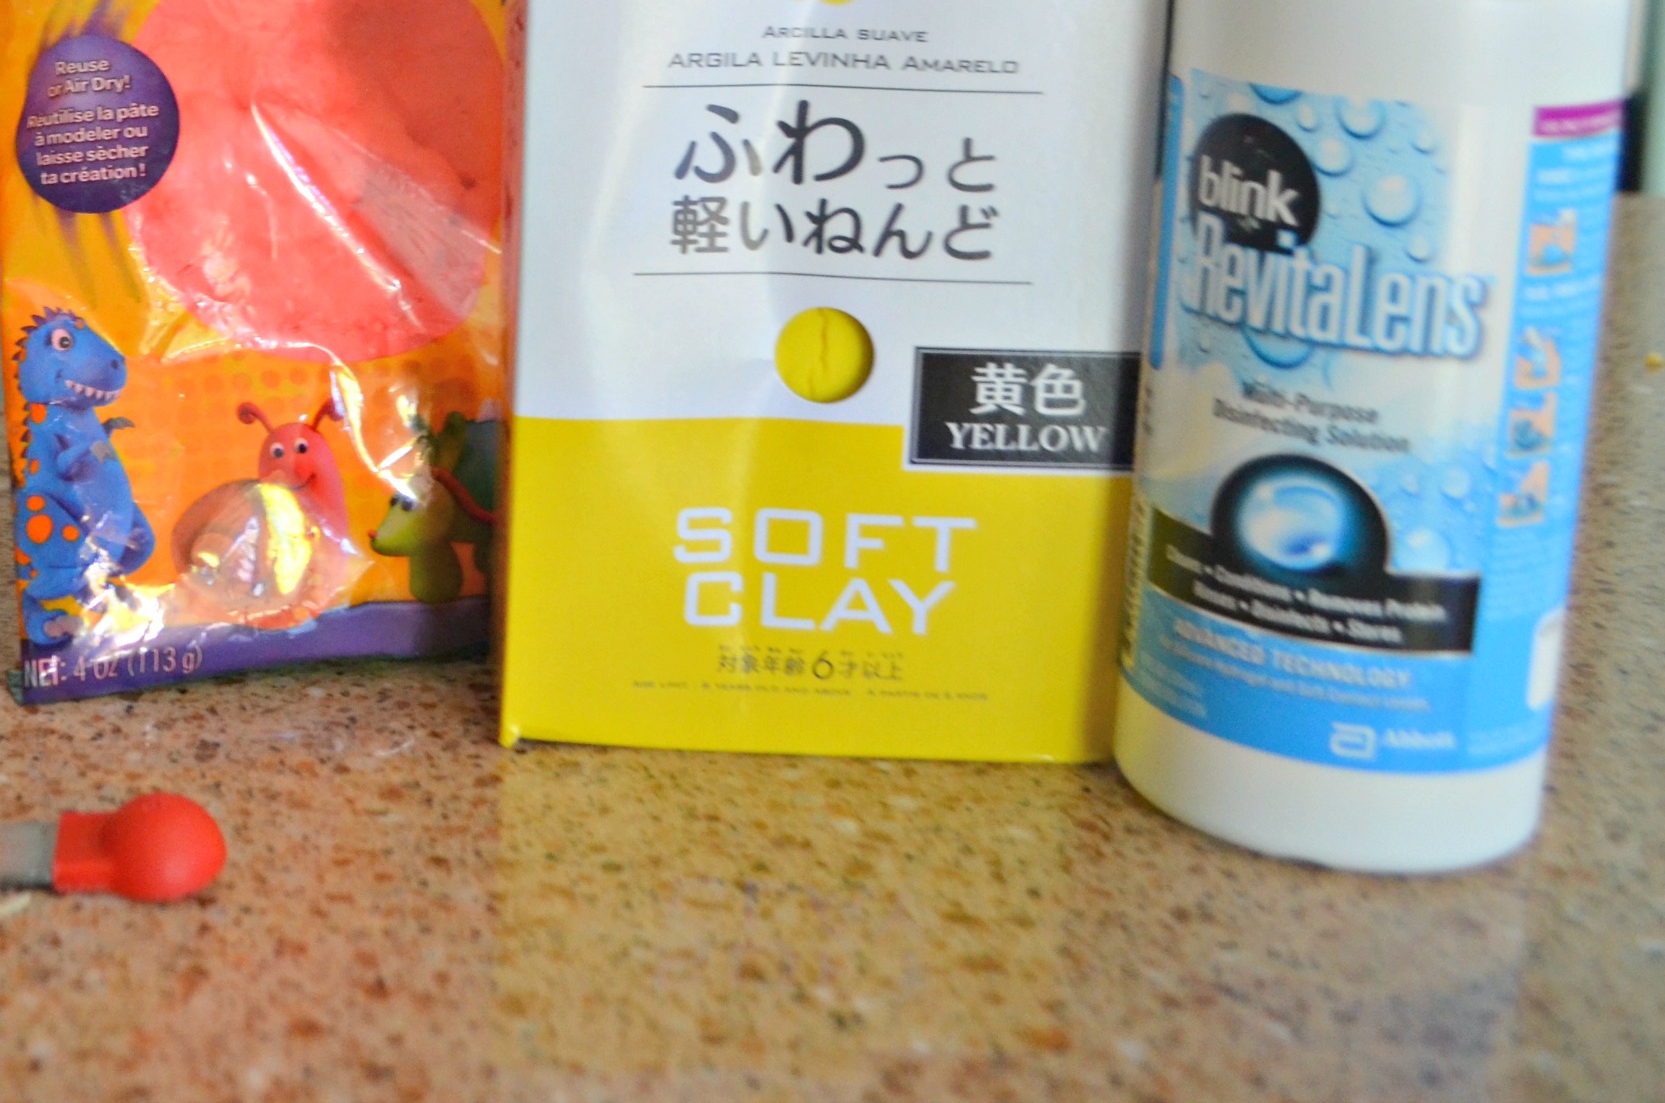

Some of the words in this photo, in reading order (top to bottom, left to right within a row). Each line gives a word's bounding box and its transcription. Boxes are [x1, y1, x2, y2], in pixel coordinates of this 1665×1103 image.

[763, 25, 848, 42] ARCILLA
[857, 28, 930, 45] SUAVE
[55, 58, 111, 76] Reuse
[667, 51, 763, 71] ARGILA
[771, 51, 891, 72] LEVINHA
[902, 55, 1020, 76] AMARELO
[47, 85, 62, 98] or
[63, 78, 89, 95] Air
[91, 74, 132, 94] Dry!
[96, 105, 115, 121] la
[115, 102, 160, 123] pâte
[46, 127, 121, 145] modeler
[123, 125, 148, 139] ou
[674, 99, 997, 192] ふわっと
[36, 149, 84, 167] laisse
[40, 170, 59, 185] ta
[59, 164, 137, 185] création
[1198, 154, 1302, 227] blink
[671, 195, 1000, 261] 軽いねんど
[1194, 211, 1490, 362] RevitaLens
[969, 362, 1086, 418] 黄色
[944, 422, 1110, 454] YELLOW
[673, 506, 978, 573] SOFT
[683, 570, 958, 637] CLAY
